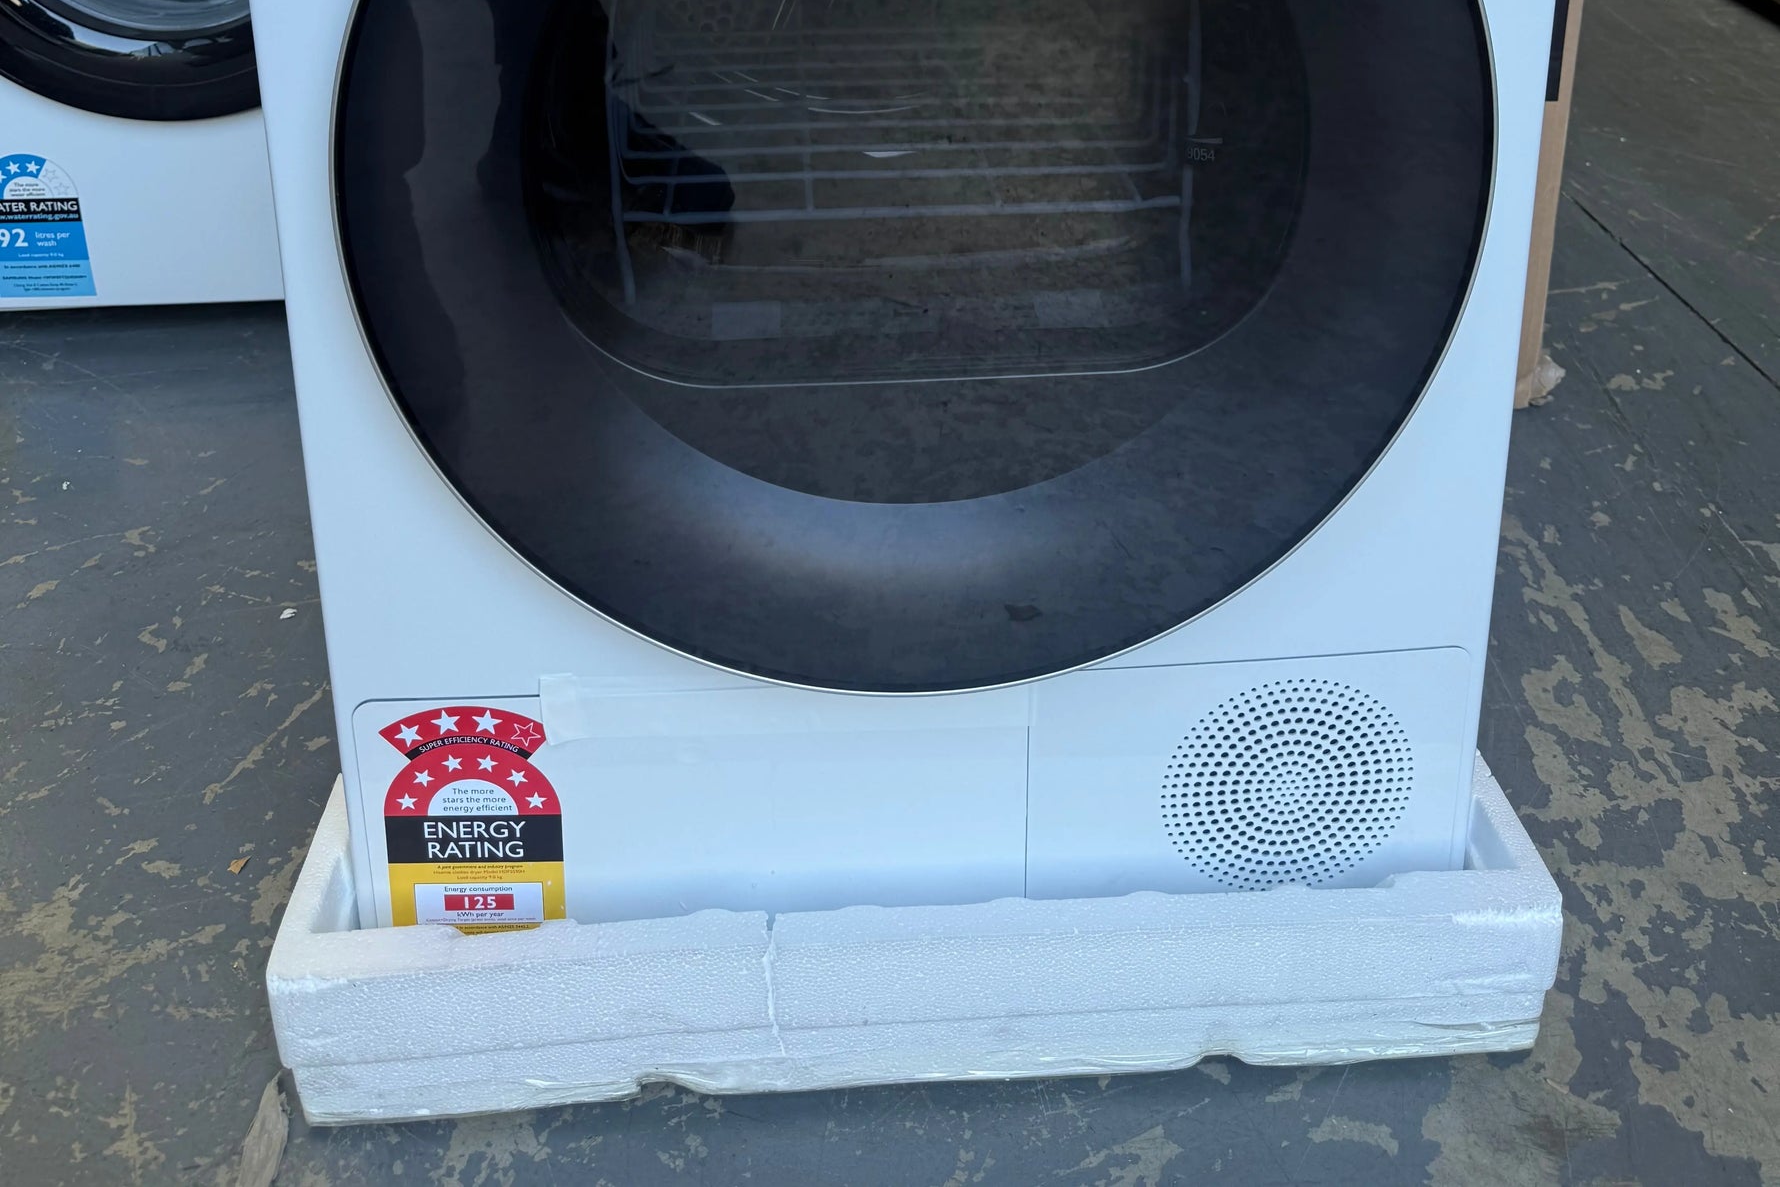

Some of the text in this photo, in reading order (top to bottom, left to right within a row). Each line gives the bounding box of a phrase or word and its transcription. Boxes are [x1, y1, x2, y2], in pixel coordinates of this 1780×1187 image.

[0, 200, 78, 213] ATER RATING
[35, 231, 55, 239] litres
[57, 231, 71, 241] per
[36, 239, 57, 247] wash
[418, 735, 520, 754] SUPER EFFICIENCY RATING
[452, 787, 469, 795] The
[442, 796, 464, 804] stars
[443, 803, 513, 814] energy efficient
[423, 820, 527, 839] ENERGY
[427, 840, 525, 859] RATING
[469, 884, 513, 893] consumption
[463, 895, 498, 909] 125
